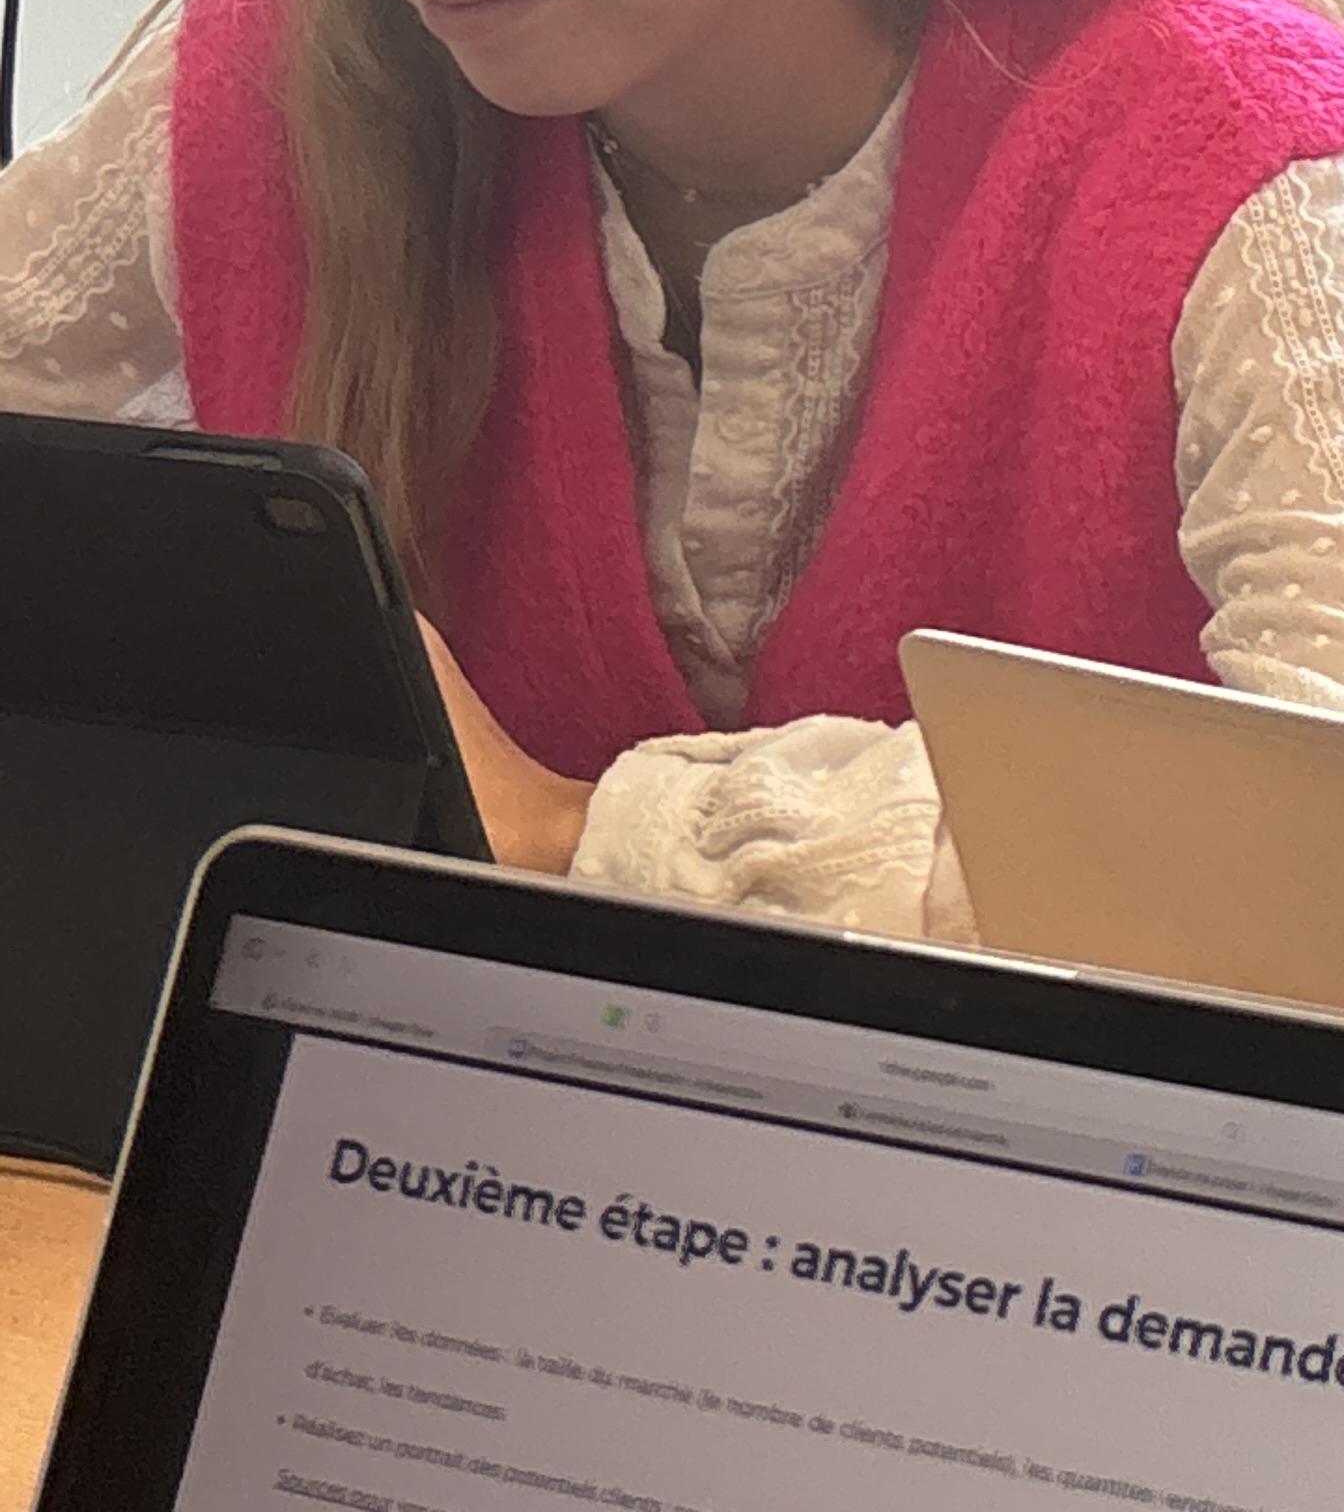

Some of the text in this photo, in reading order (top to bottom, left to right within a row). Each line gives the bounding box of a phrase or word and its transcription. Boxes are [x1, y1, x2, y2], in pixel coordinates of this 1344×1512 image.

[329, 1137, 586, 1233] Deuxième
[600, 1190, 748, 1267] étape
[761, 1233, 780, 1272] :
[790, 1237, 1022, 1322] analyser
[1035, 1278, 1079, 1333] la
[727, 1396, 803, 1428] nombre
[808, 1412, 836, 1436] de
